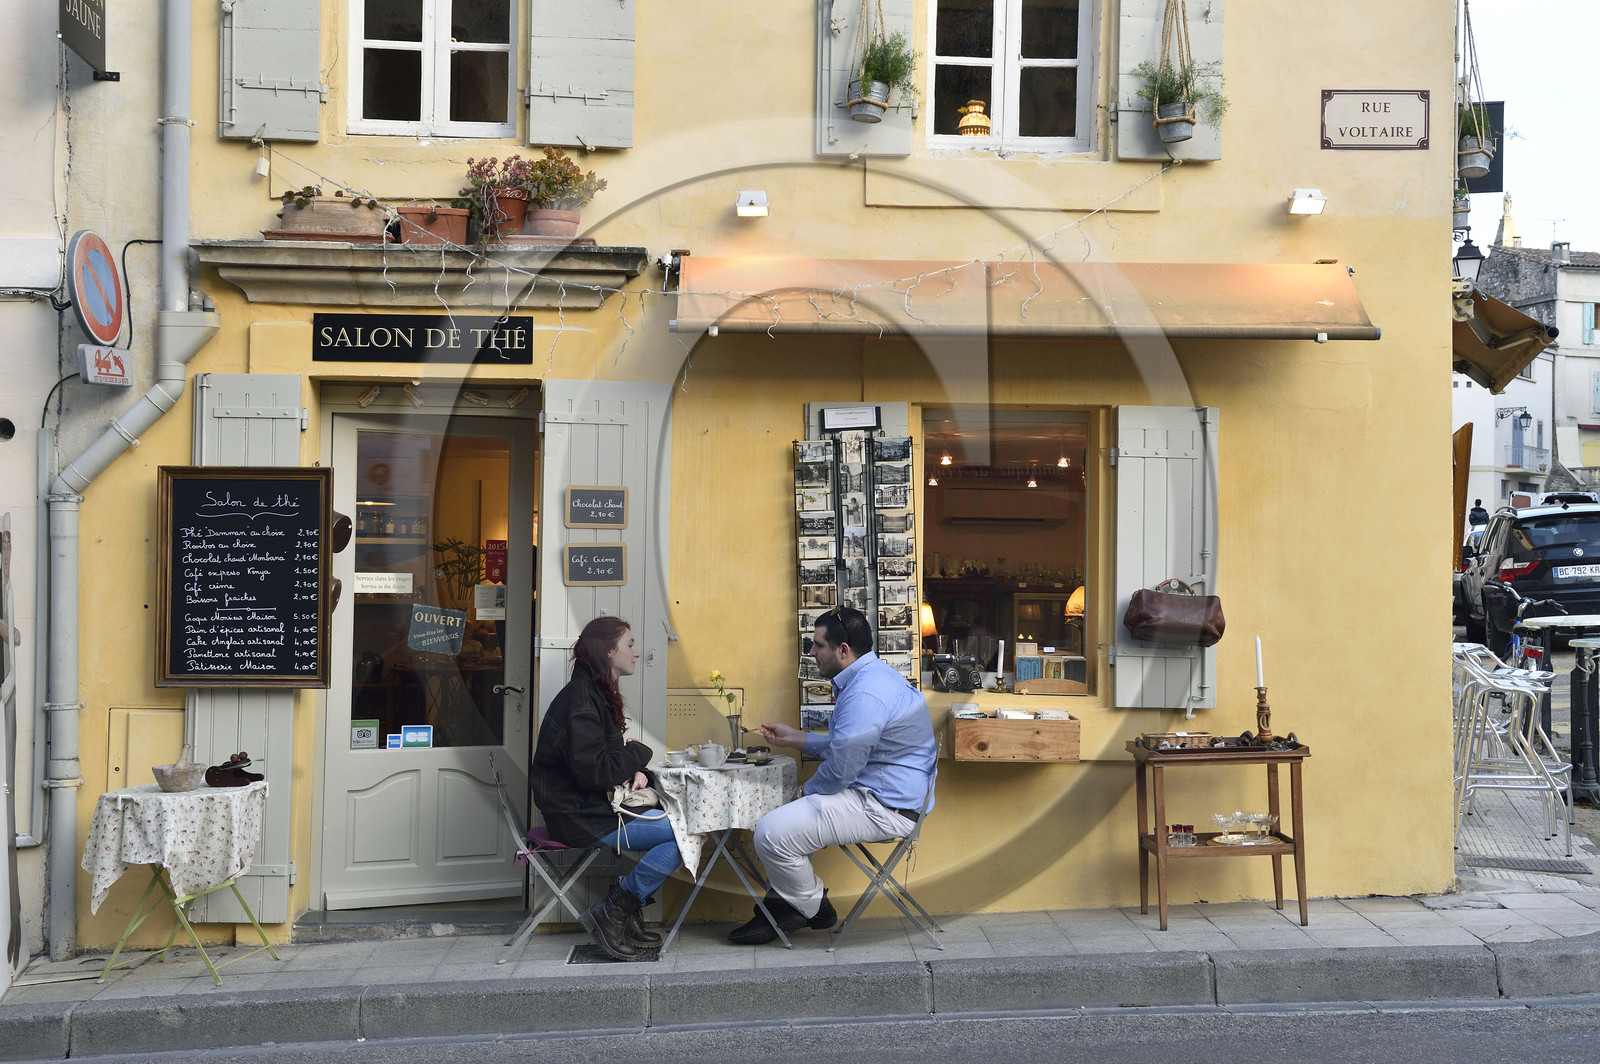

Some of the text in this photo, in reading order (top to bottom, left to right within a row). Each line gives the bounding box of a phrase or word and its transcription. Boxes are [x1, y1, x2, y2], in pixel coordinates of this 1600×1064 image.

[1361, 102, 1391, 113] RUE
[1339, 127, 1414, 138] VOLTAIRE
[320, 326, 527, 350] SALON DE THÉ
[201, 491, 300, 508] Salon de thé
[572, 499, 603, 508] Chocolat
[262, 525, 285, 536] choix
[183, 540, 216, 550] Rooibos
[232, 539, 257, 549] choix
[182, 553, 222, 564] Chocolat
[223, 553, 246, 563] chaud
[571, 555, 588, 567] Café
[184, 567, 204, 581] Café
[247, 567, 271, 581] Kenya
[184, 582, 202, 597] Café
[186, 595, 218, 604] Boissons
[211, 612, 243, 621] Monsieur
[246, 611, 277, 621] Maison
[414, 611, 462, 628] OUVERT
[184, 625, 208, 634] Pain
[247, 622, 285, 633] artisanal
[186, 636, 207, 646] Cake
[211, 636, 245, 650] Anglais
[247, 635, 285, 646] artisanal
[422, 632, 459, 646] BIENVENUS
[183, 648, 230, 658] Panettone
[234, 648, 277, 658] artisanal
[186, 660, 233, 671] Pâtisserie
[240, 660, 277, 670] Maison
